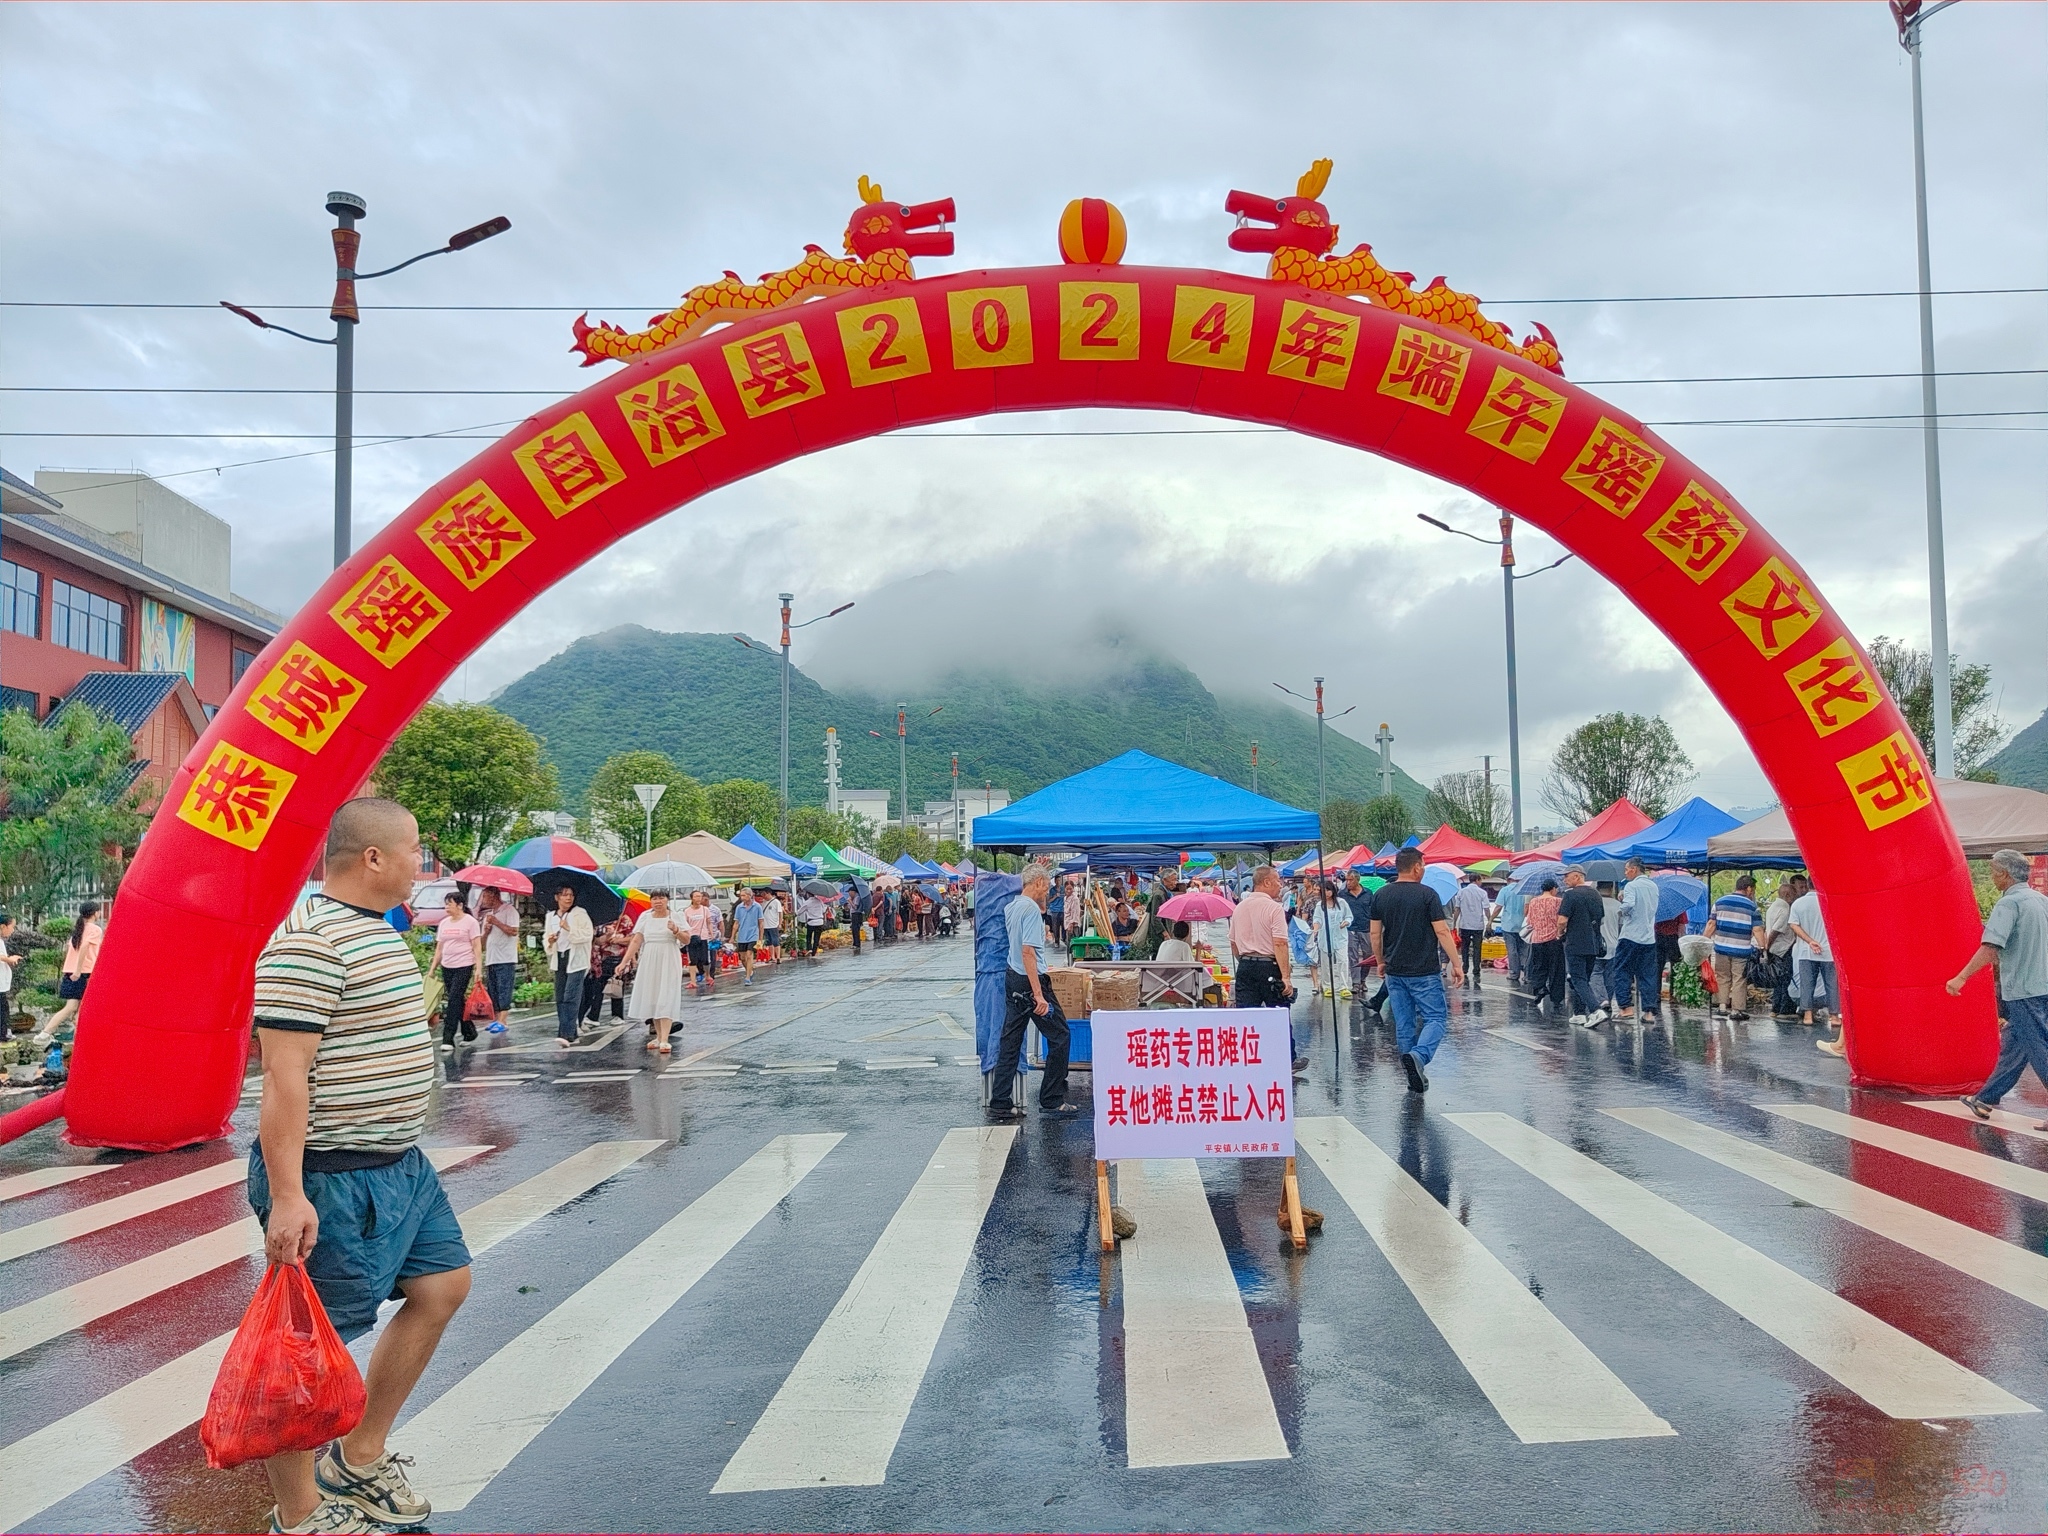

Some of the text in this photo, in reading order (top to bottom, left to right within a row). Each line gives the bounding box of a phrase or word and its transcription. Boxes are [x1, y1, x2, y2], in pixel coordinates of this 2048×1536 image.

[194, 288, 1931, 836] 恭城瑶族自治县2024年端午瑶药文化节
[1126, 1025, 1262, 1069] 瑶药专用摊位
[1107, 1081, 1286, 1126] 其他摊点禁止入内
[1204, 1142, 1268, 1153] 平安镇人民政府
